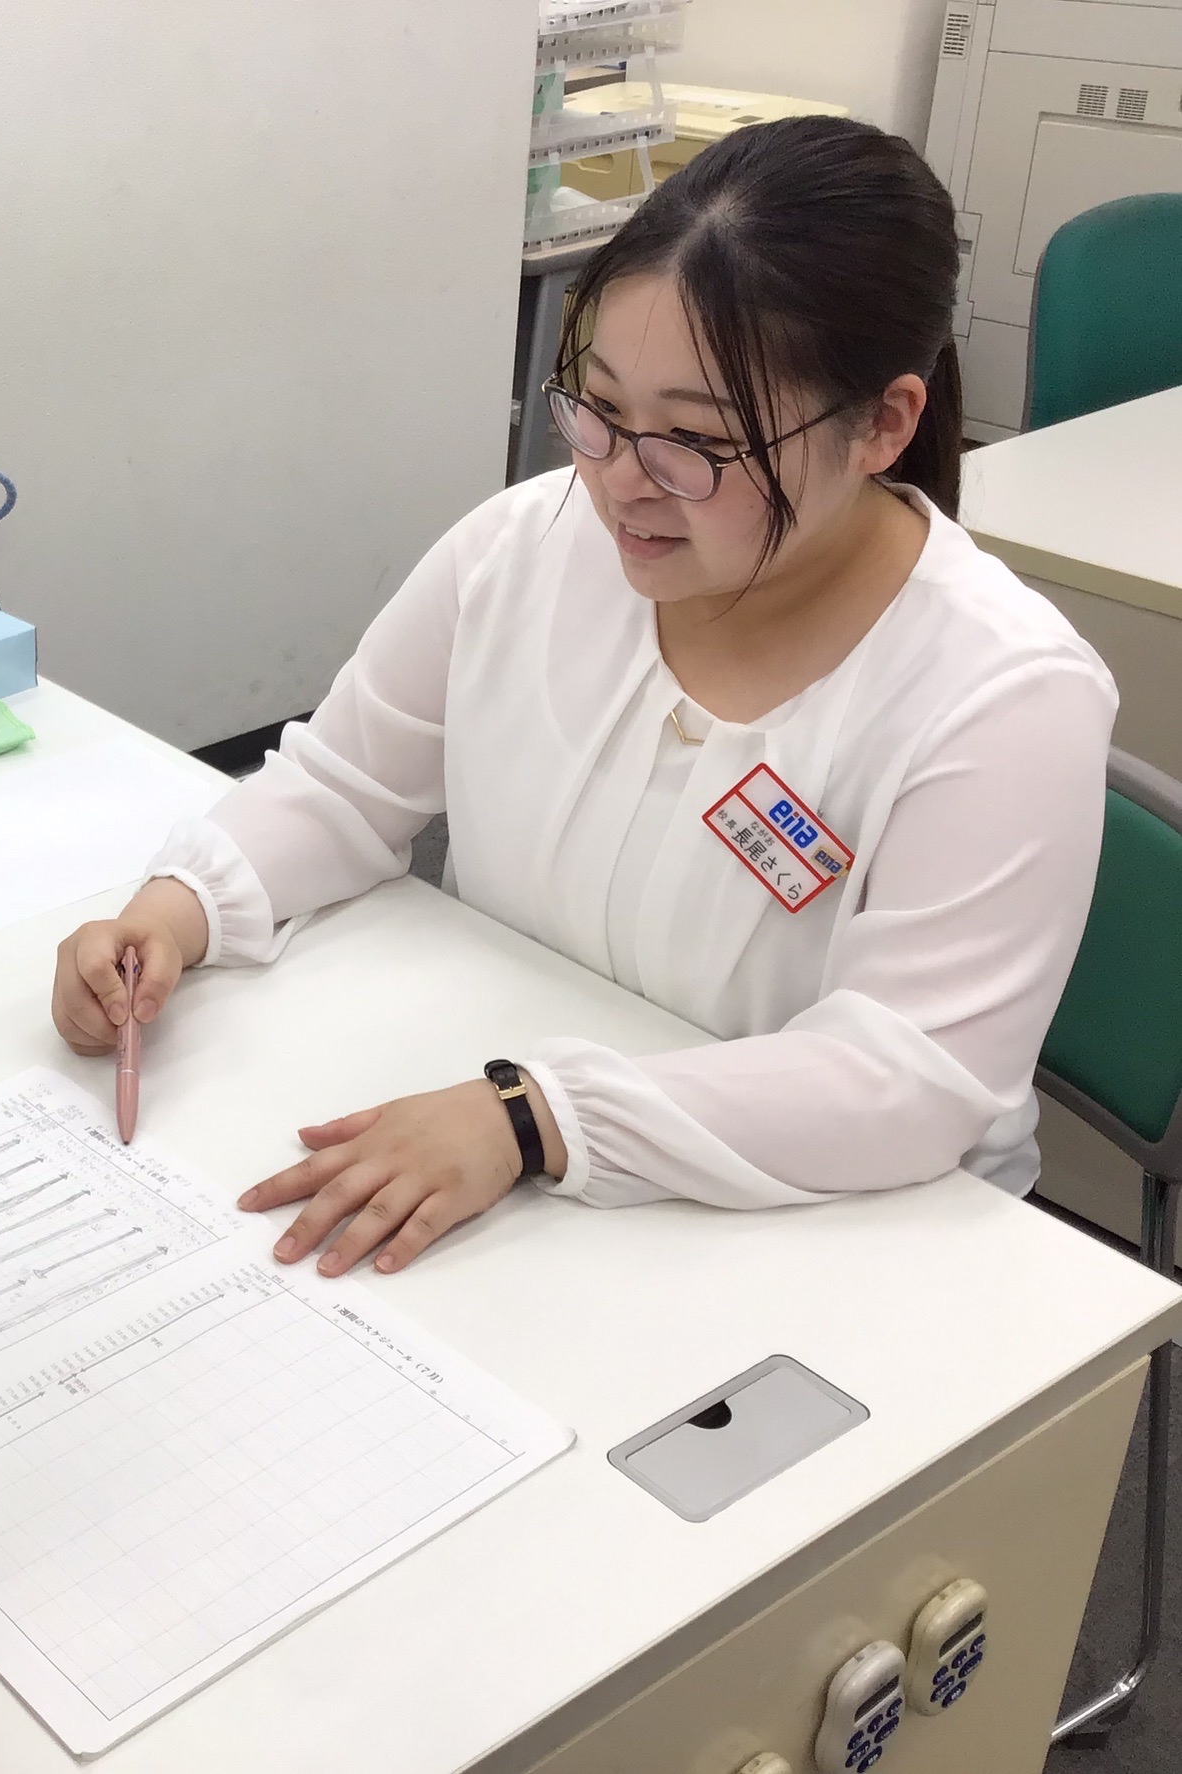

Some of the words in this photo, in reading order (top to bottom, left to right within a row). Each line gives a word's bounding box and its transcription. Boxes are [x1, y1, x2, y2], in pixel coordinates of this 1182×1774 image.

[768, 799, 818, 849] ena
[731, 827, 803, 900] 長尾さくら
